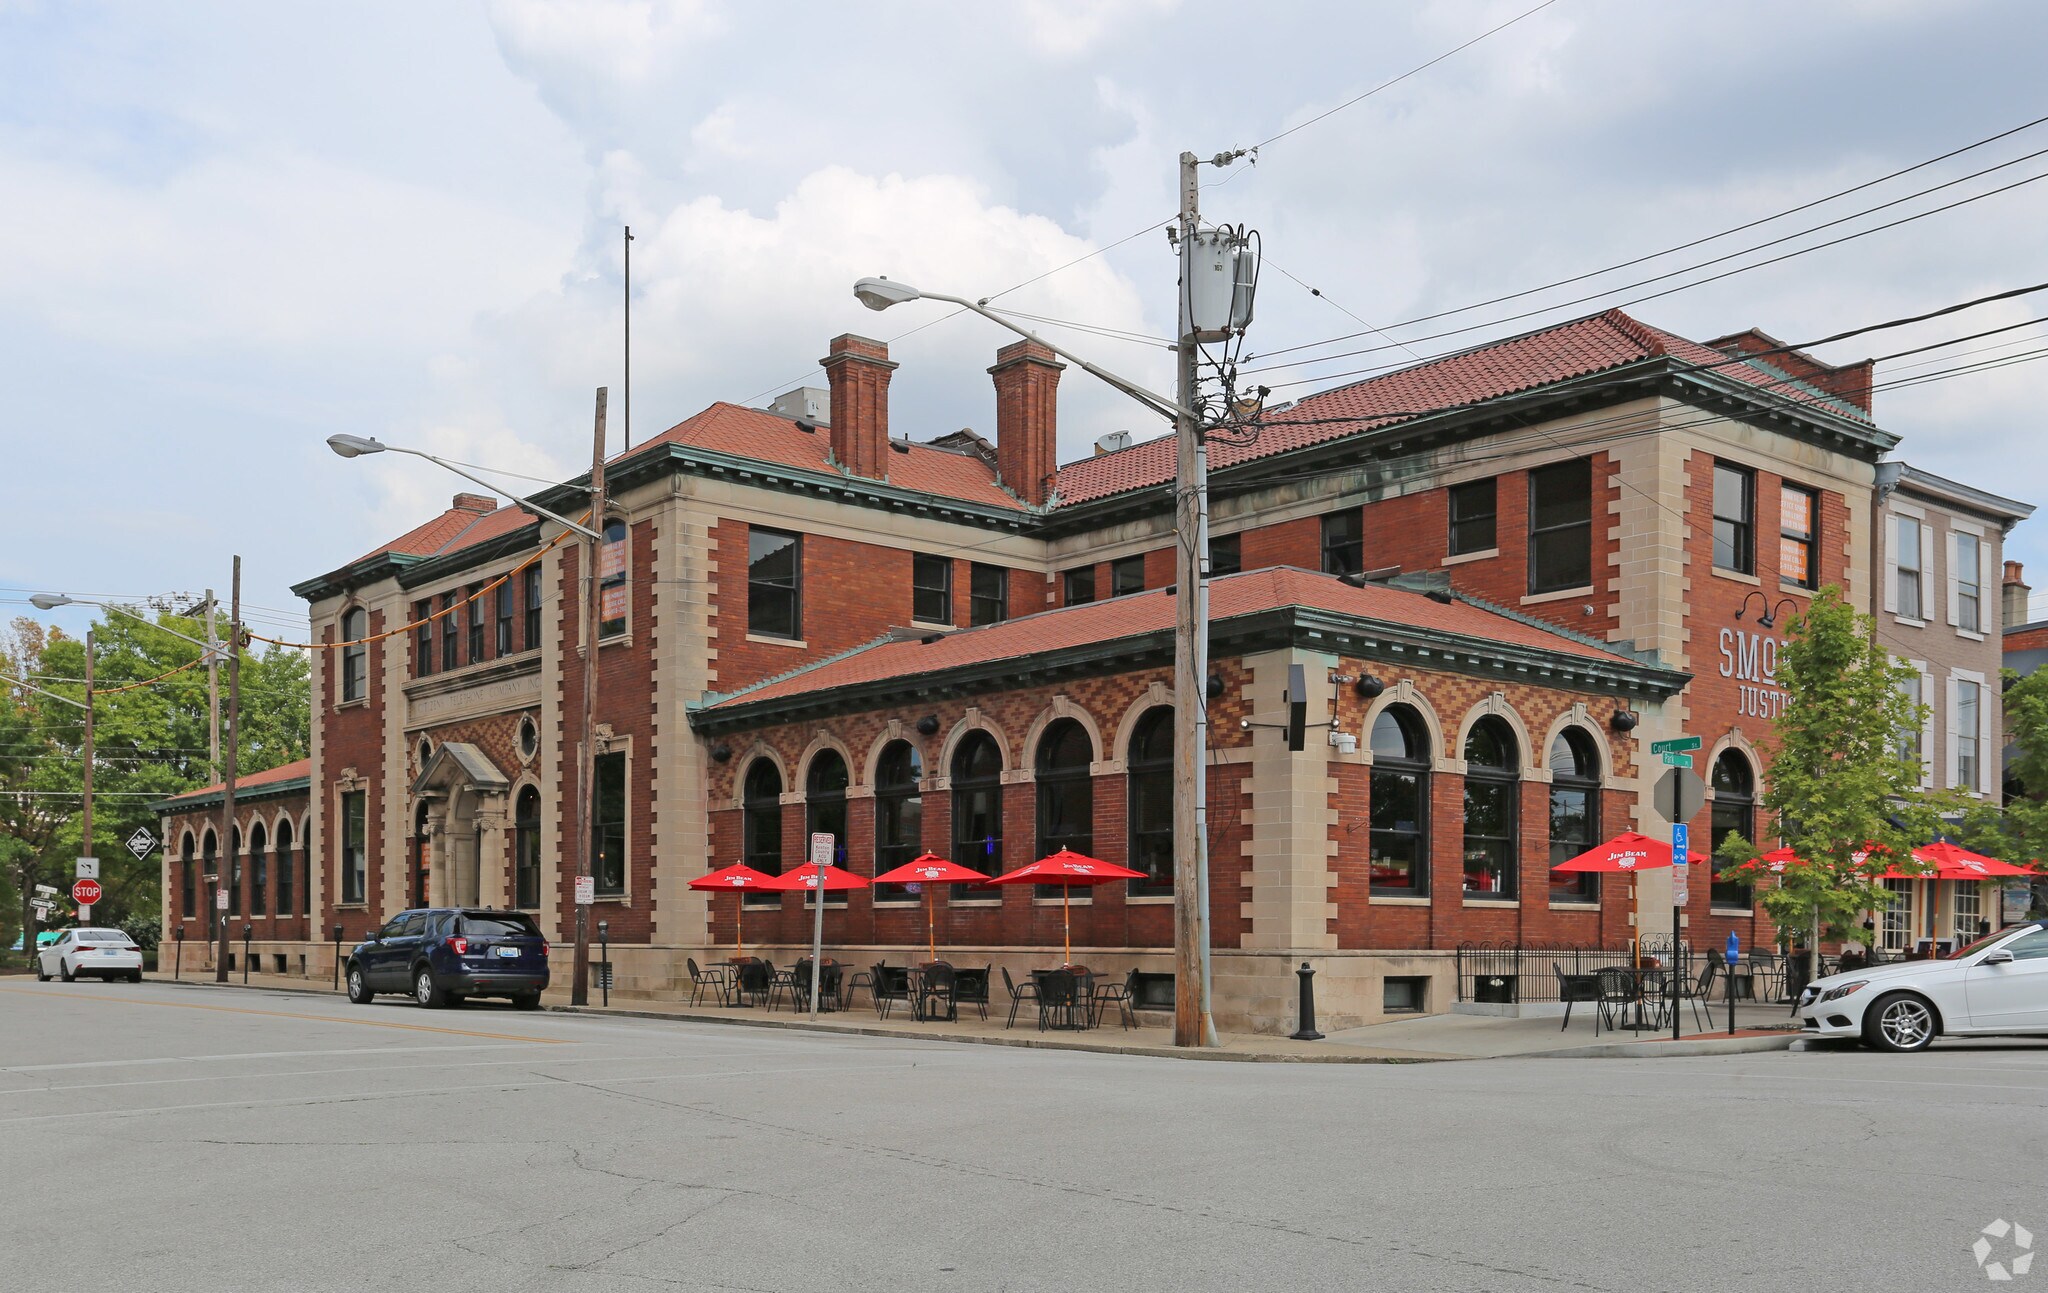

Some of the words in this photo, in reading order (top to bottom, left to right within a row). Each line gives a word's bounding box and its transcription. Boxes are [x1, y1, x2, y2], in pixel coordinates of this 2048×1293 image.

[489, 680, 522, 698] COMPANY
[1653, 743, 1672, 754] Court
[1664, 753, 1674, 764] Park
[1607, 853, 1624, 861] JIM
[75, 887, 99, 897] STOP
